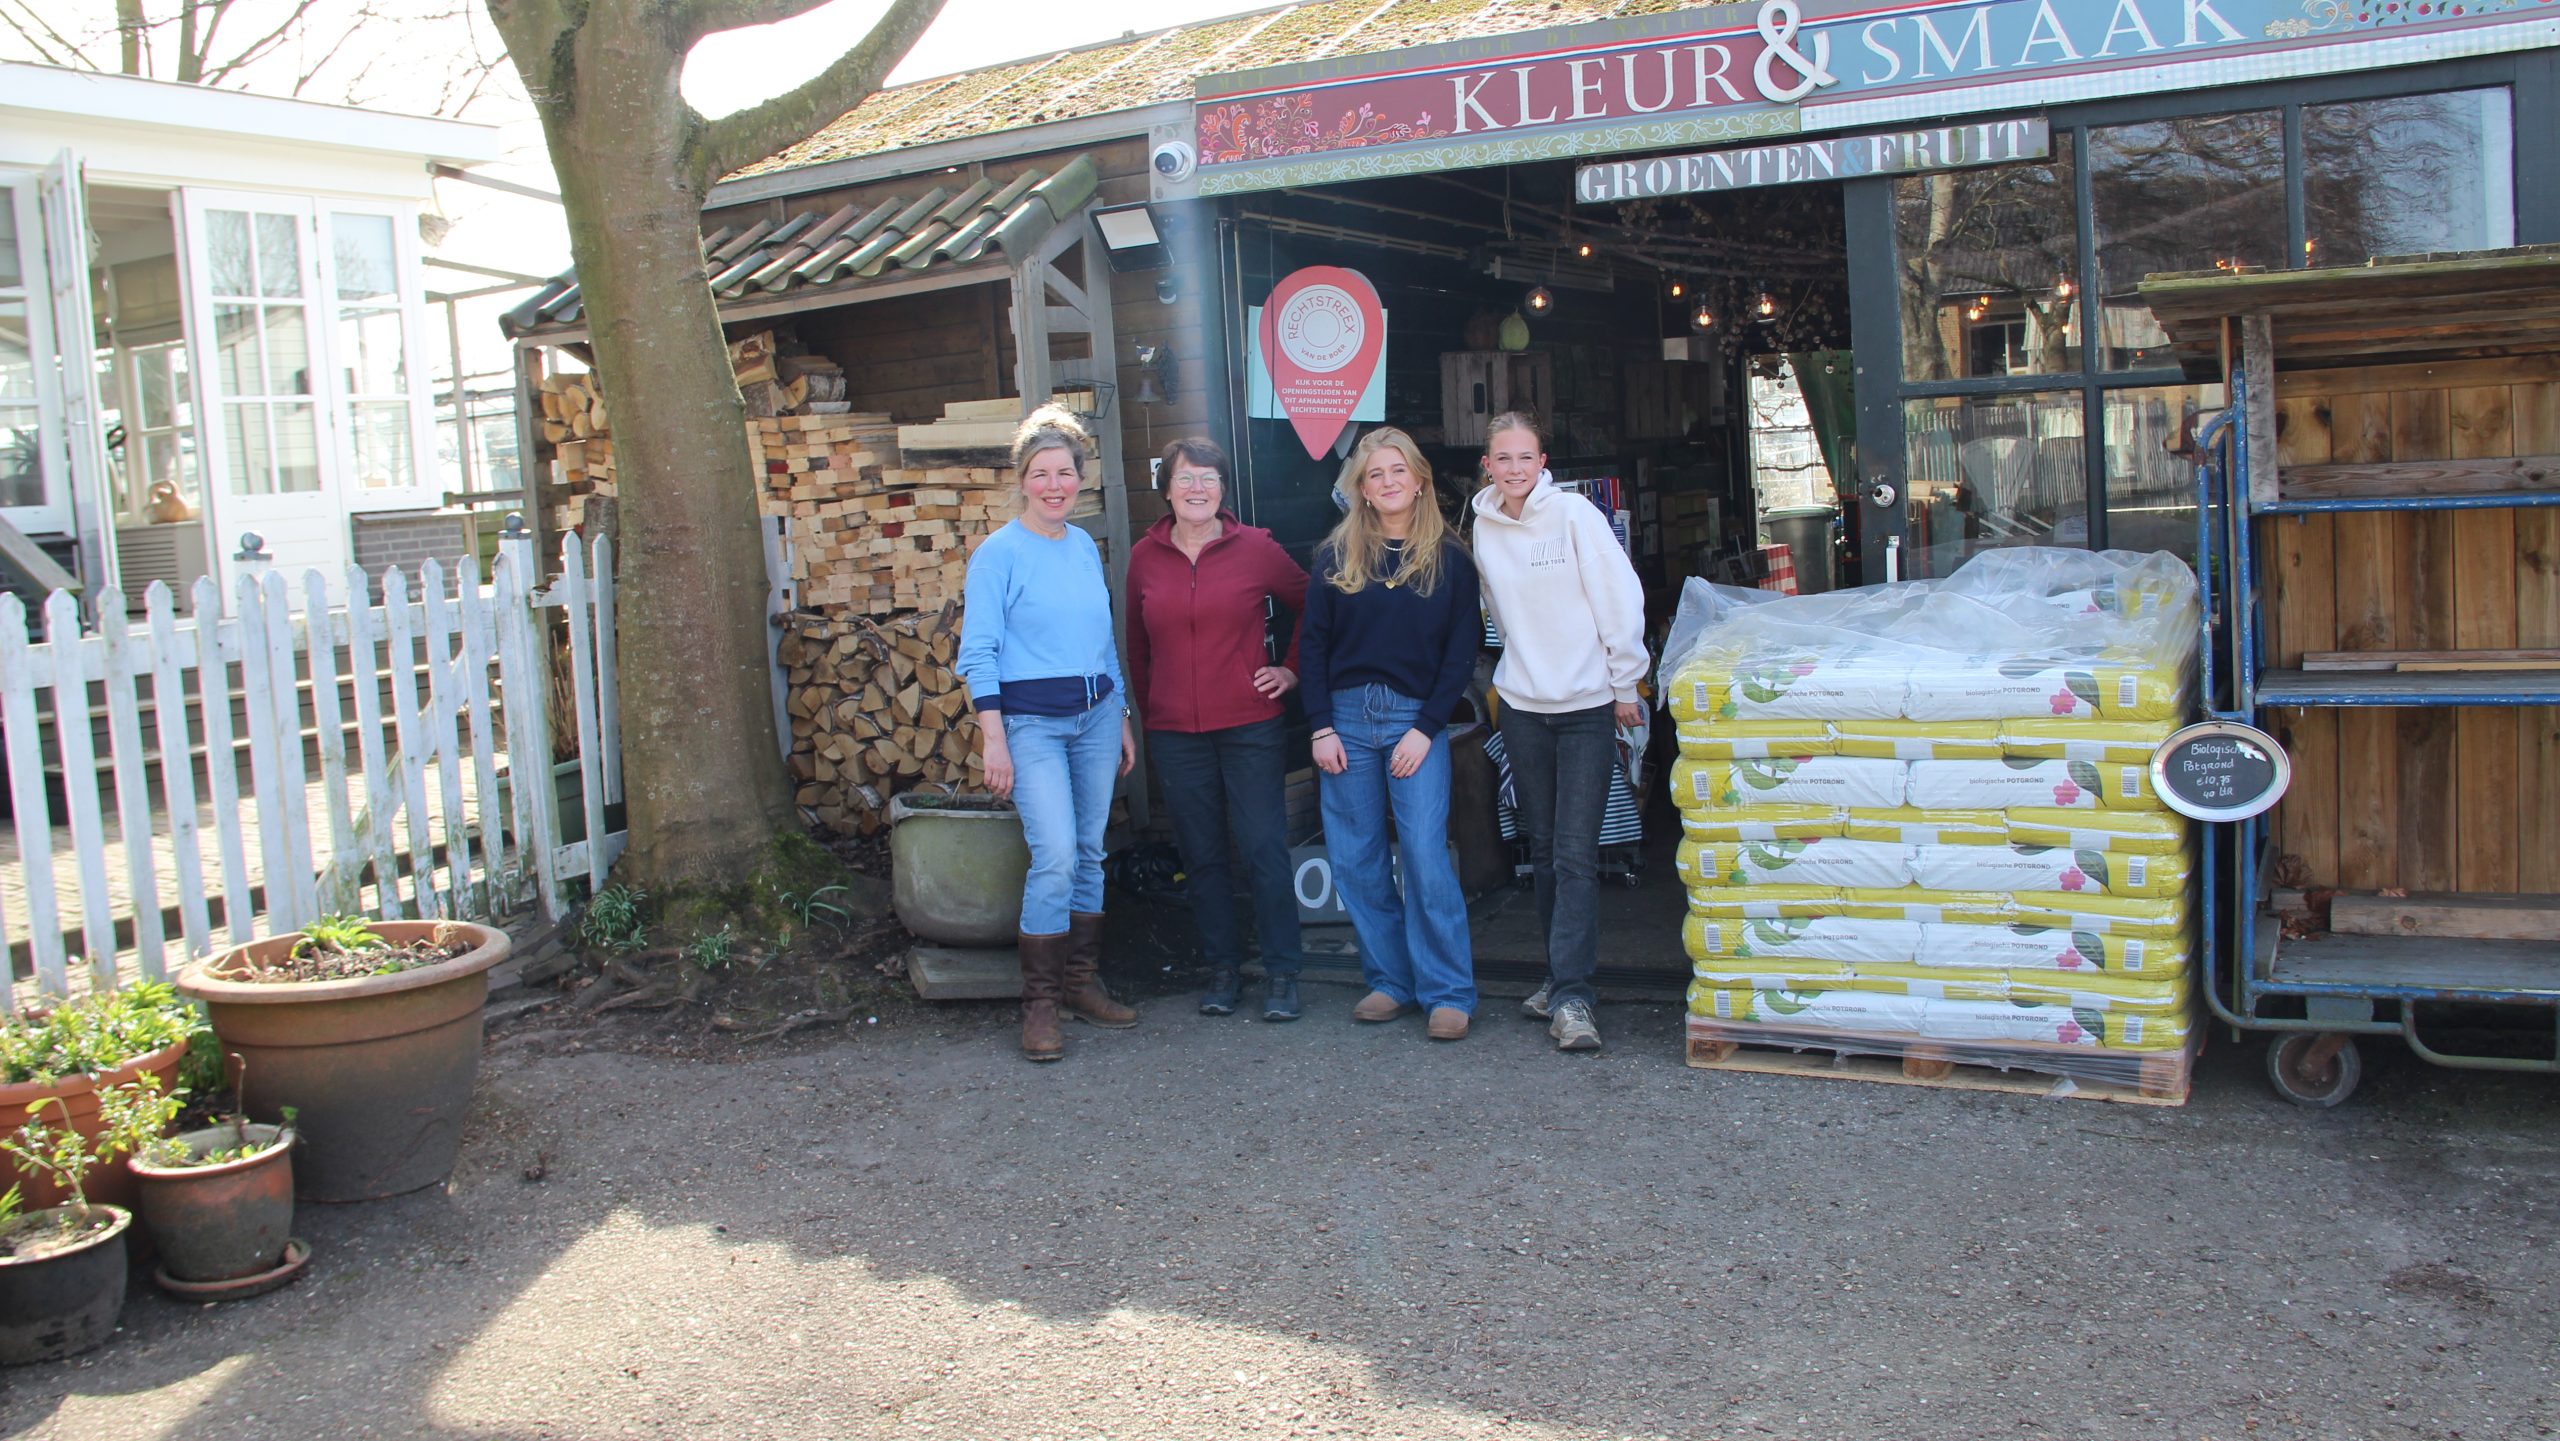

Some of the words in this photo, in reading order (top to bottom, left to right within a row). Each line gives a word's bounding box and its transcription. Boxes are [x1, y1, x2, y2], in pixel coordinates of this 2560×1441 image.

[1439, 38, 1511, 59] VOOR
[1546, 29, 1579, 46] DE
[1615, 8, 1739, 36] NATUUR
[1447, 44, 1747, 135] KLEUR
[1753, 0, 1841, 104] &
[1862, 0, 2249, 86] SMAAK
[1579, 140, 1837, 201] GROENTEN
[1868, 119, 2029, 173] FRUIT
[1288, 296, 1356, 340] RECHTSTREEX
[1300, 348, 1317, 360] VAN
[1329, 344, 1347, 359] BOER
[1312, 379, 1333, 387] VOOR
[1281, 388, 1341, 396] OPENINGSTIJDEN
[1290, 406, 1348, 414] RECHTSTREEX.NL
[1965, 688, 2001, 696] biologische
[2203, 790, 2216, 799] 40
[1976, 861, 2013, 869] biologische
[1974, 941, 2010, 949] biologische
[2011, 942, 2049, 950] POTGROND
[1831, 1005, 1867, 1013] POTGROND
[2011, 1014, 2049, 1022] POTGROND
